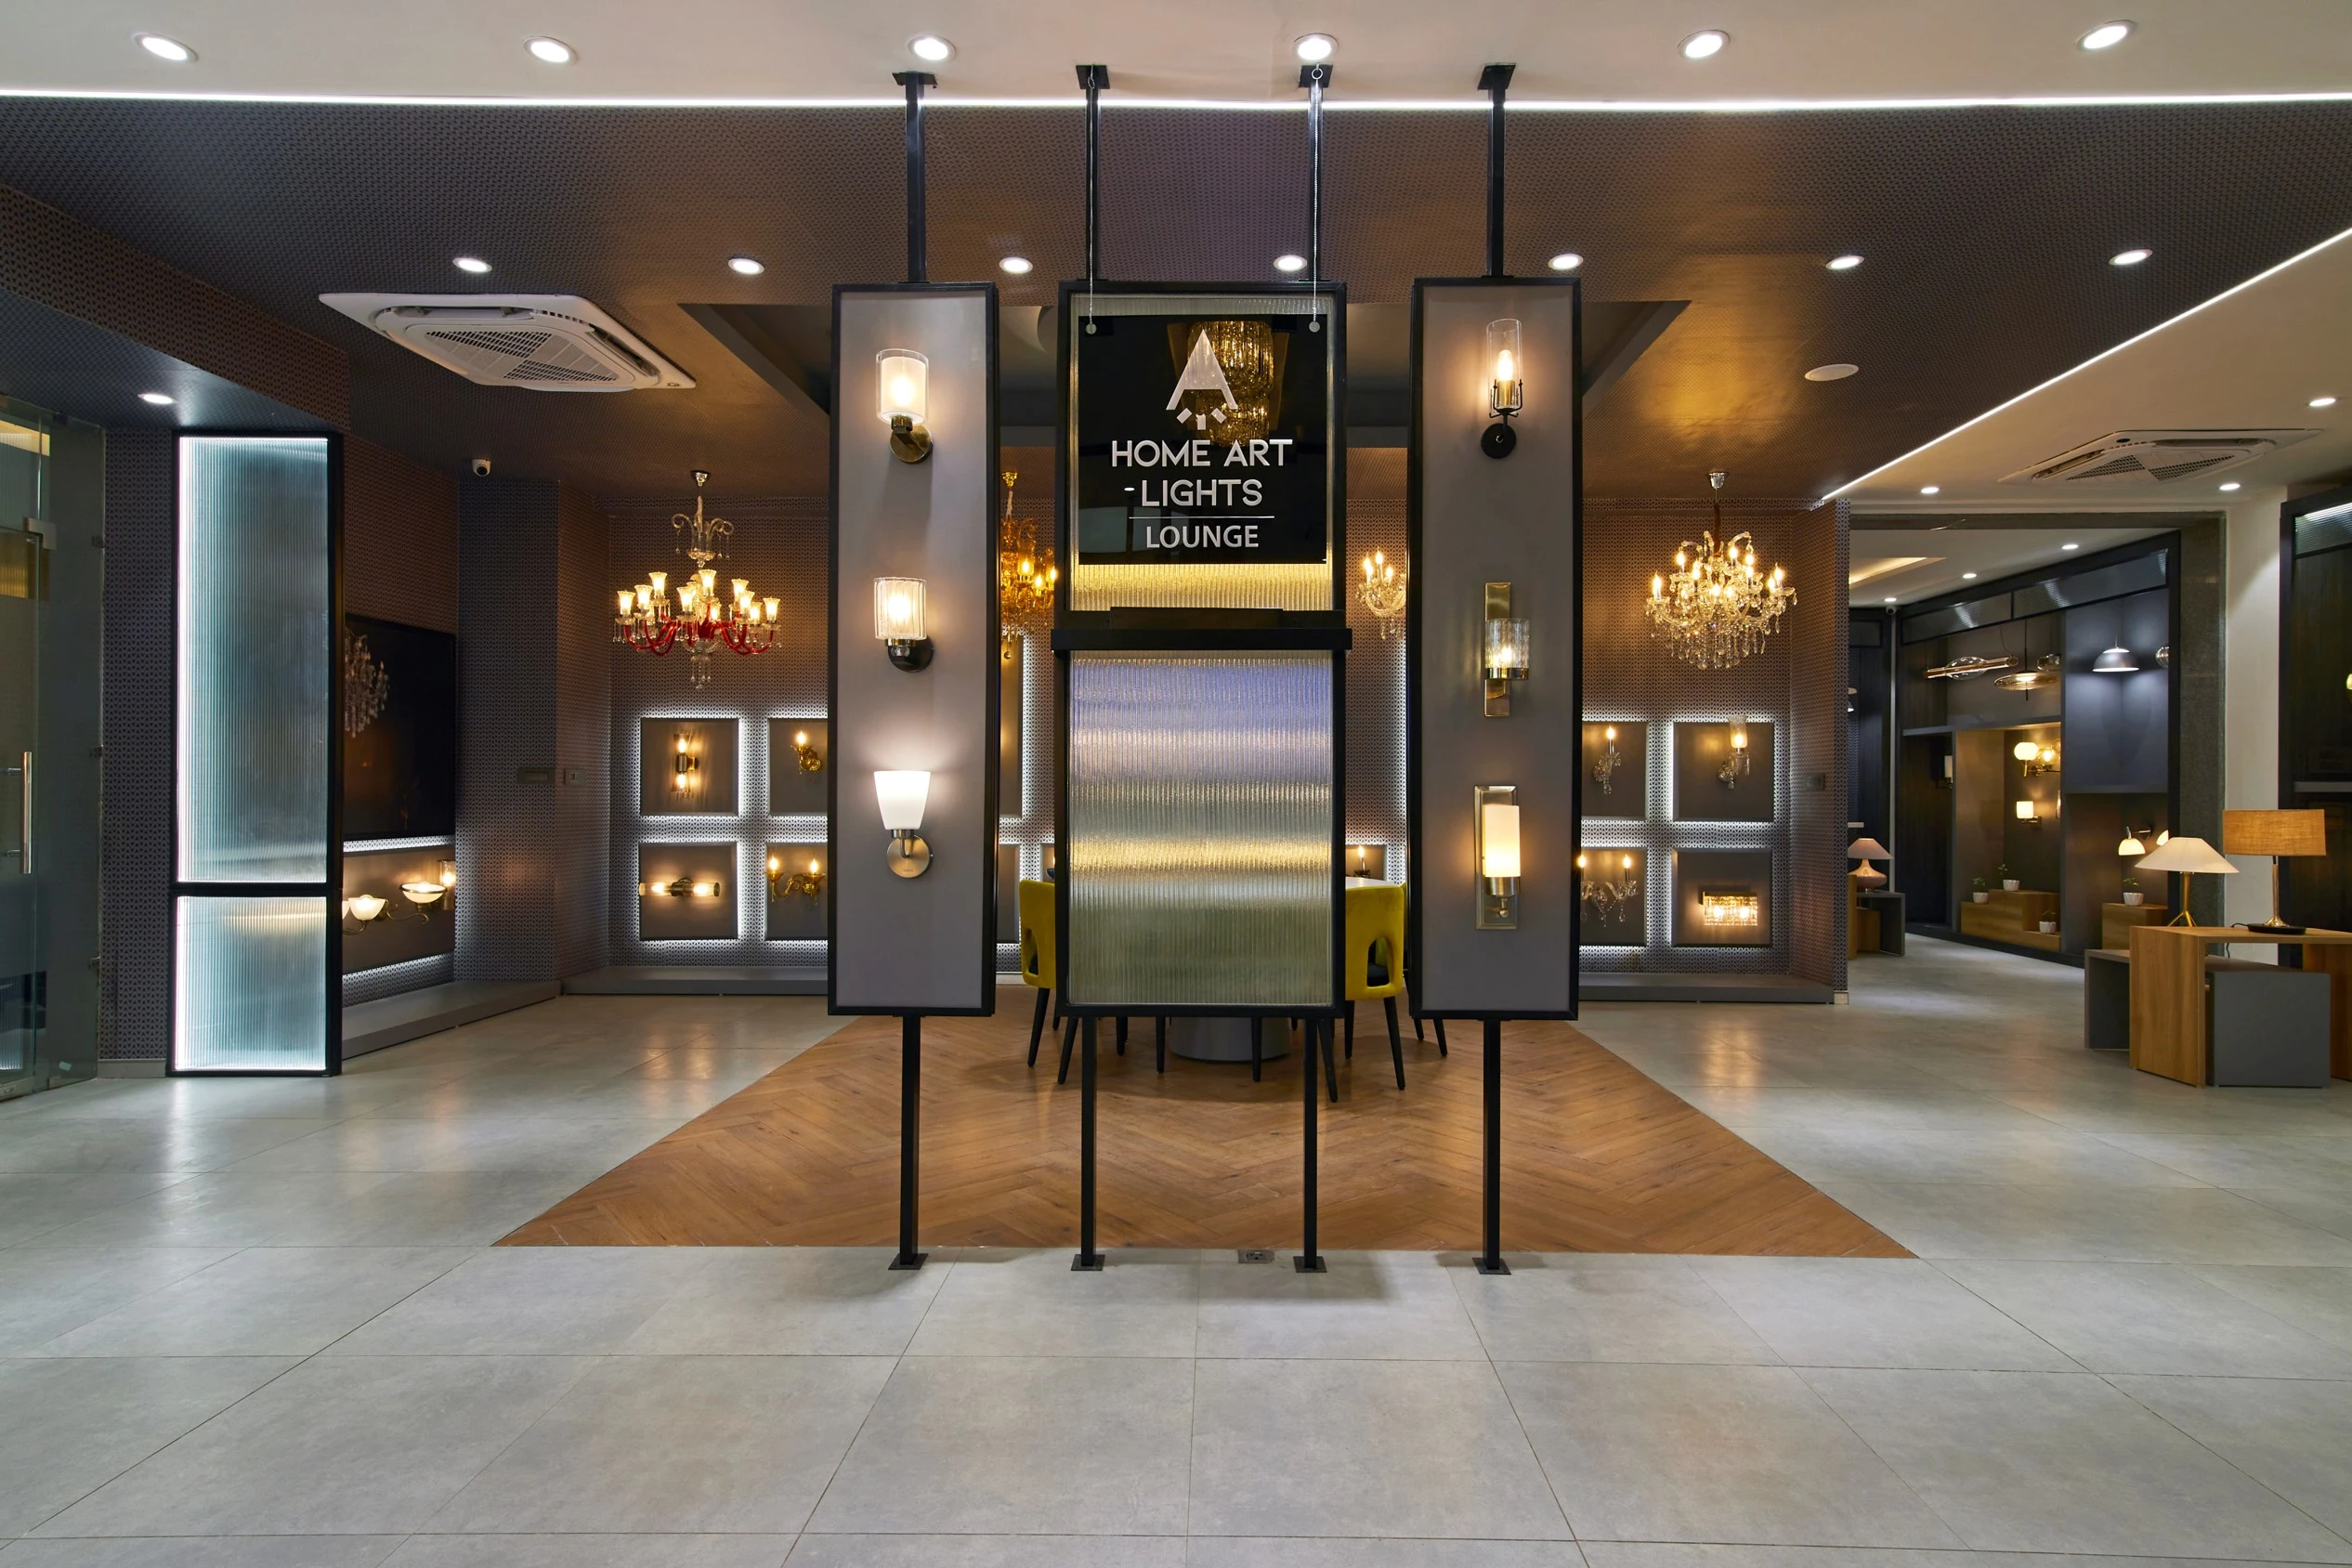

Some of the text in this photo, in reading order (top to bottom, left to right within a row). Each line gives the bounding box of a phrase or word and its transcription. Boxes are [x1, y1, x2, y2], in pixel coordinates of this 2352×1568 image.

[1112, 438, 1293, 467] HOME ART
[1142, 479, 1262, 507] LIGHTS
[1146, 525, 1260, 548] LOUNGE
